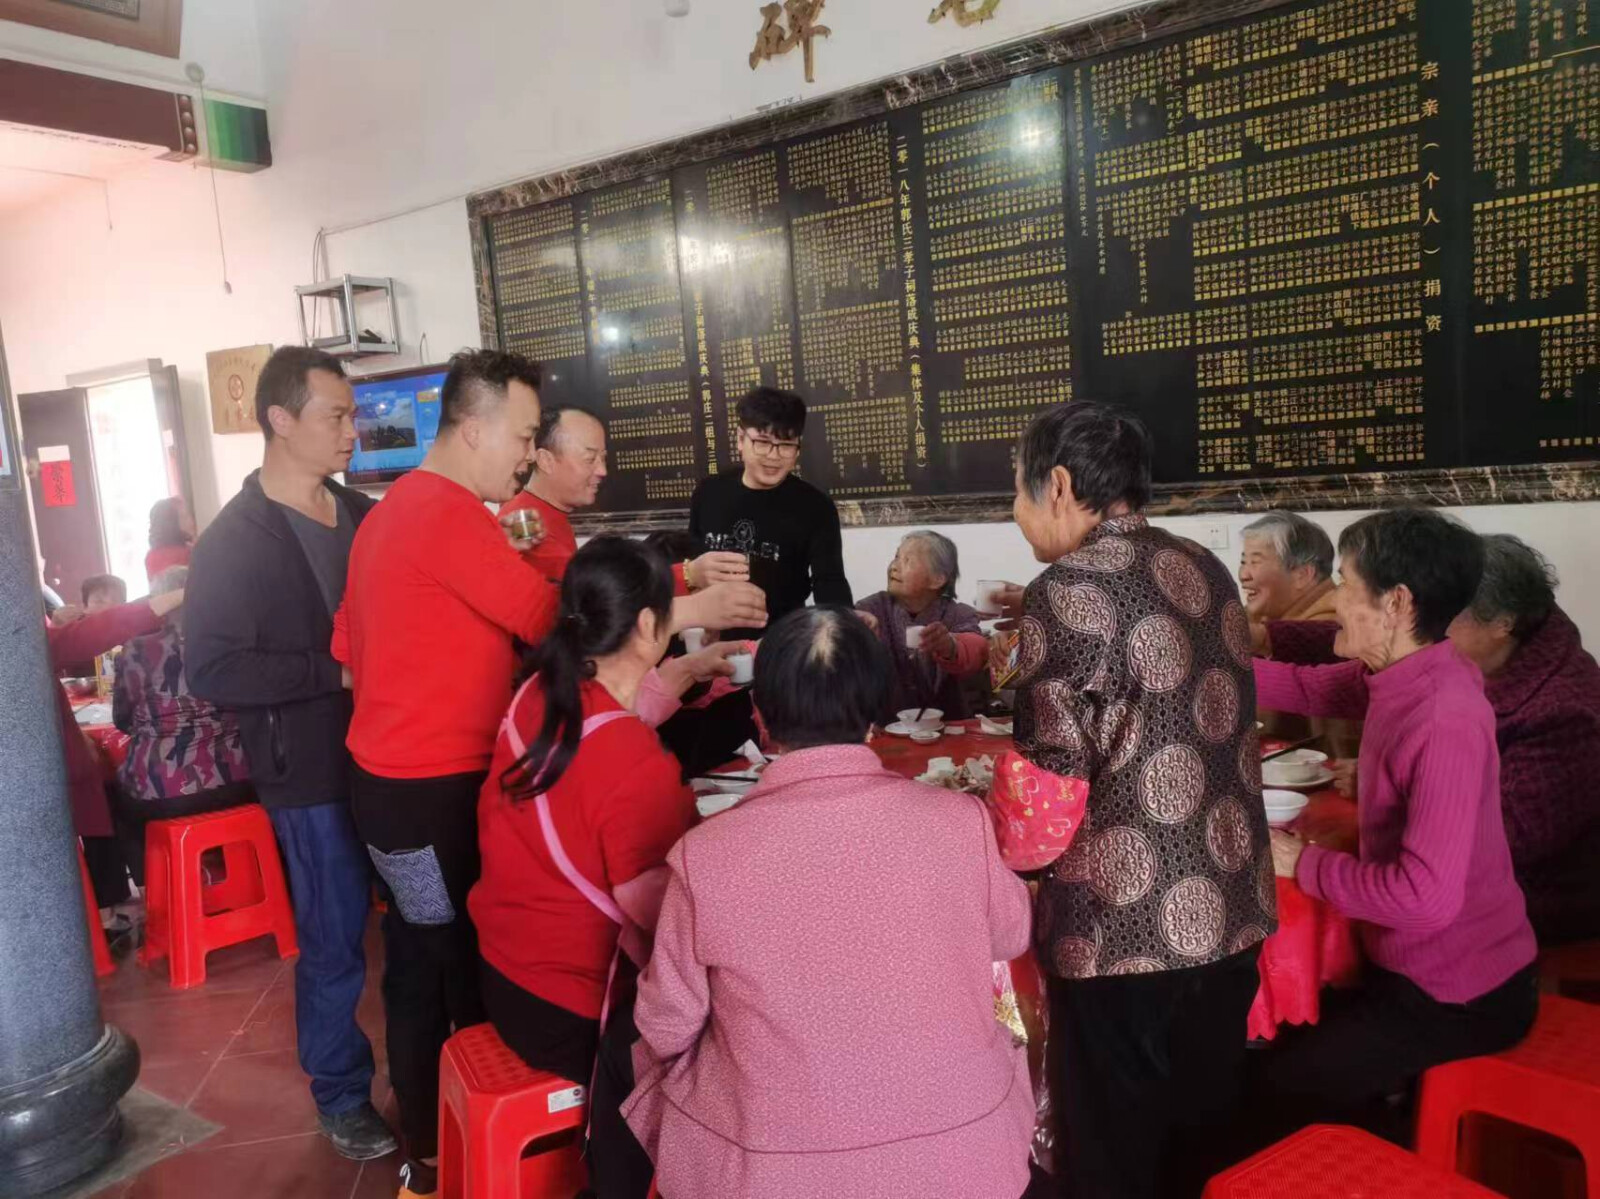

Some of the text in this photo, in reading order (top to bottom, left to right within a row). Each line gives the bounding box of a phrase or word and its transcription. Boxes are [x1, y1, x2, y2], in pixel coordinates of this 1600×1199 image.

[1420, 61, 1442, 334] 宗亲（个人）捐资
